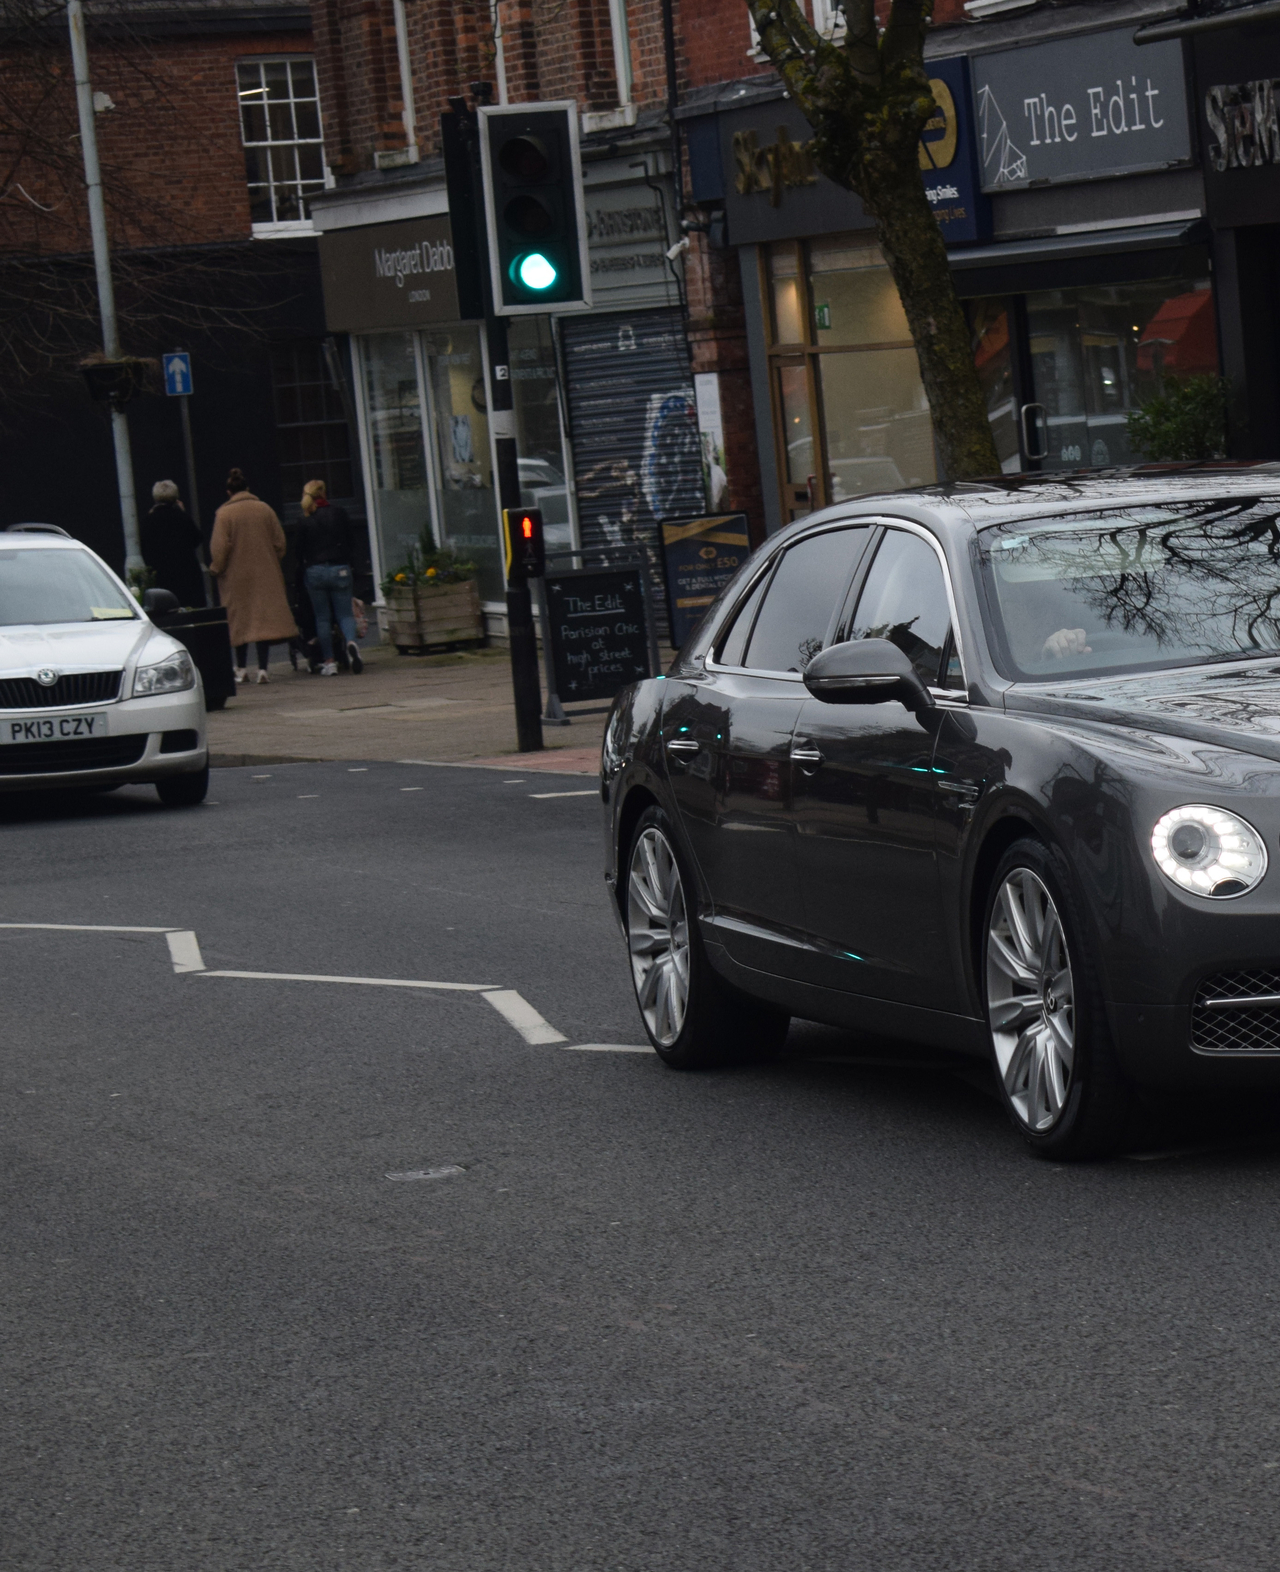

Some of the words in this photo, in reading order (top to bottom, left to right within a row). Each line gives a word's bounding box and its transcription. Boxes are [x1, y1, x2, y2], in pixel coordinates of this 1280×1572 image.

[1024, 92, 1078, 146] The
[1087, 75, 1164, 137] Edit
[374, 243, 424, 288] Margaret
[422, 239, 455, 272] Dabb
[564, 597, 592, 612] The
[594, 594, 625, 611] Edit
[561, 625, 610, 640] Parisian
[614, 622, 640, 636] Chic
[591, 638, 606, 650] at
[567, 650, 592, 671] high
[599, 647, 633, 662] street
[588, 663, 624, 681] prices
[11, 721, 53, 741] PK13
[59, 717, 95, 737] CZY
